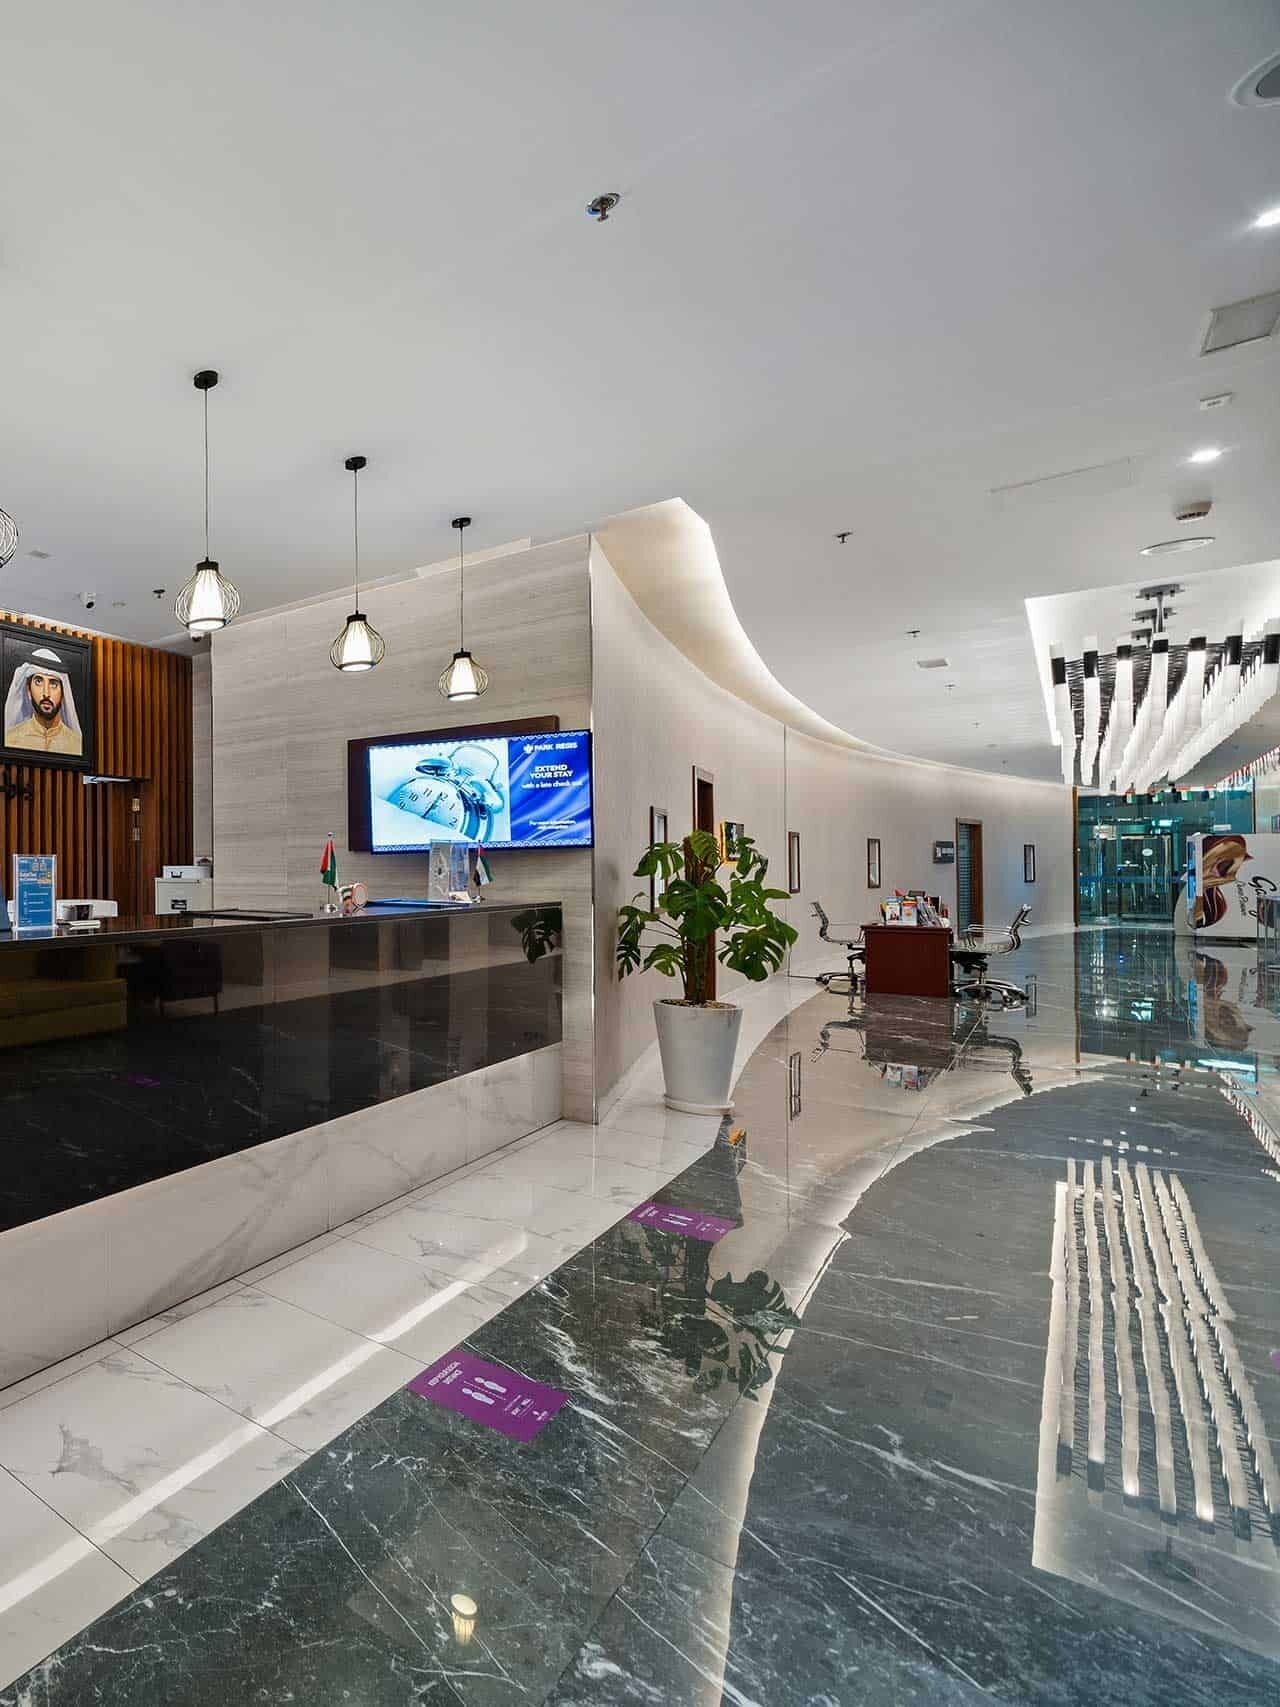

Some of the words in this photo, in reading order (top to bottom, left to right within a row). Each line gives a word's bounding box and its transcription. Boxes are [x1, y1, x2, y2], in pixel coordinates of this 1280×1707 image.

[534, 743, 554, 752] PARK
[555, 742, 578, 750] REGIS
[535, 764, 568, 772] EXTEND
[530, 771, 552, 779] YOUR
[553, 770, 573, 778] STAY
